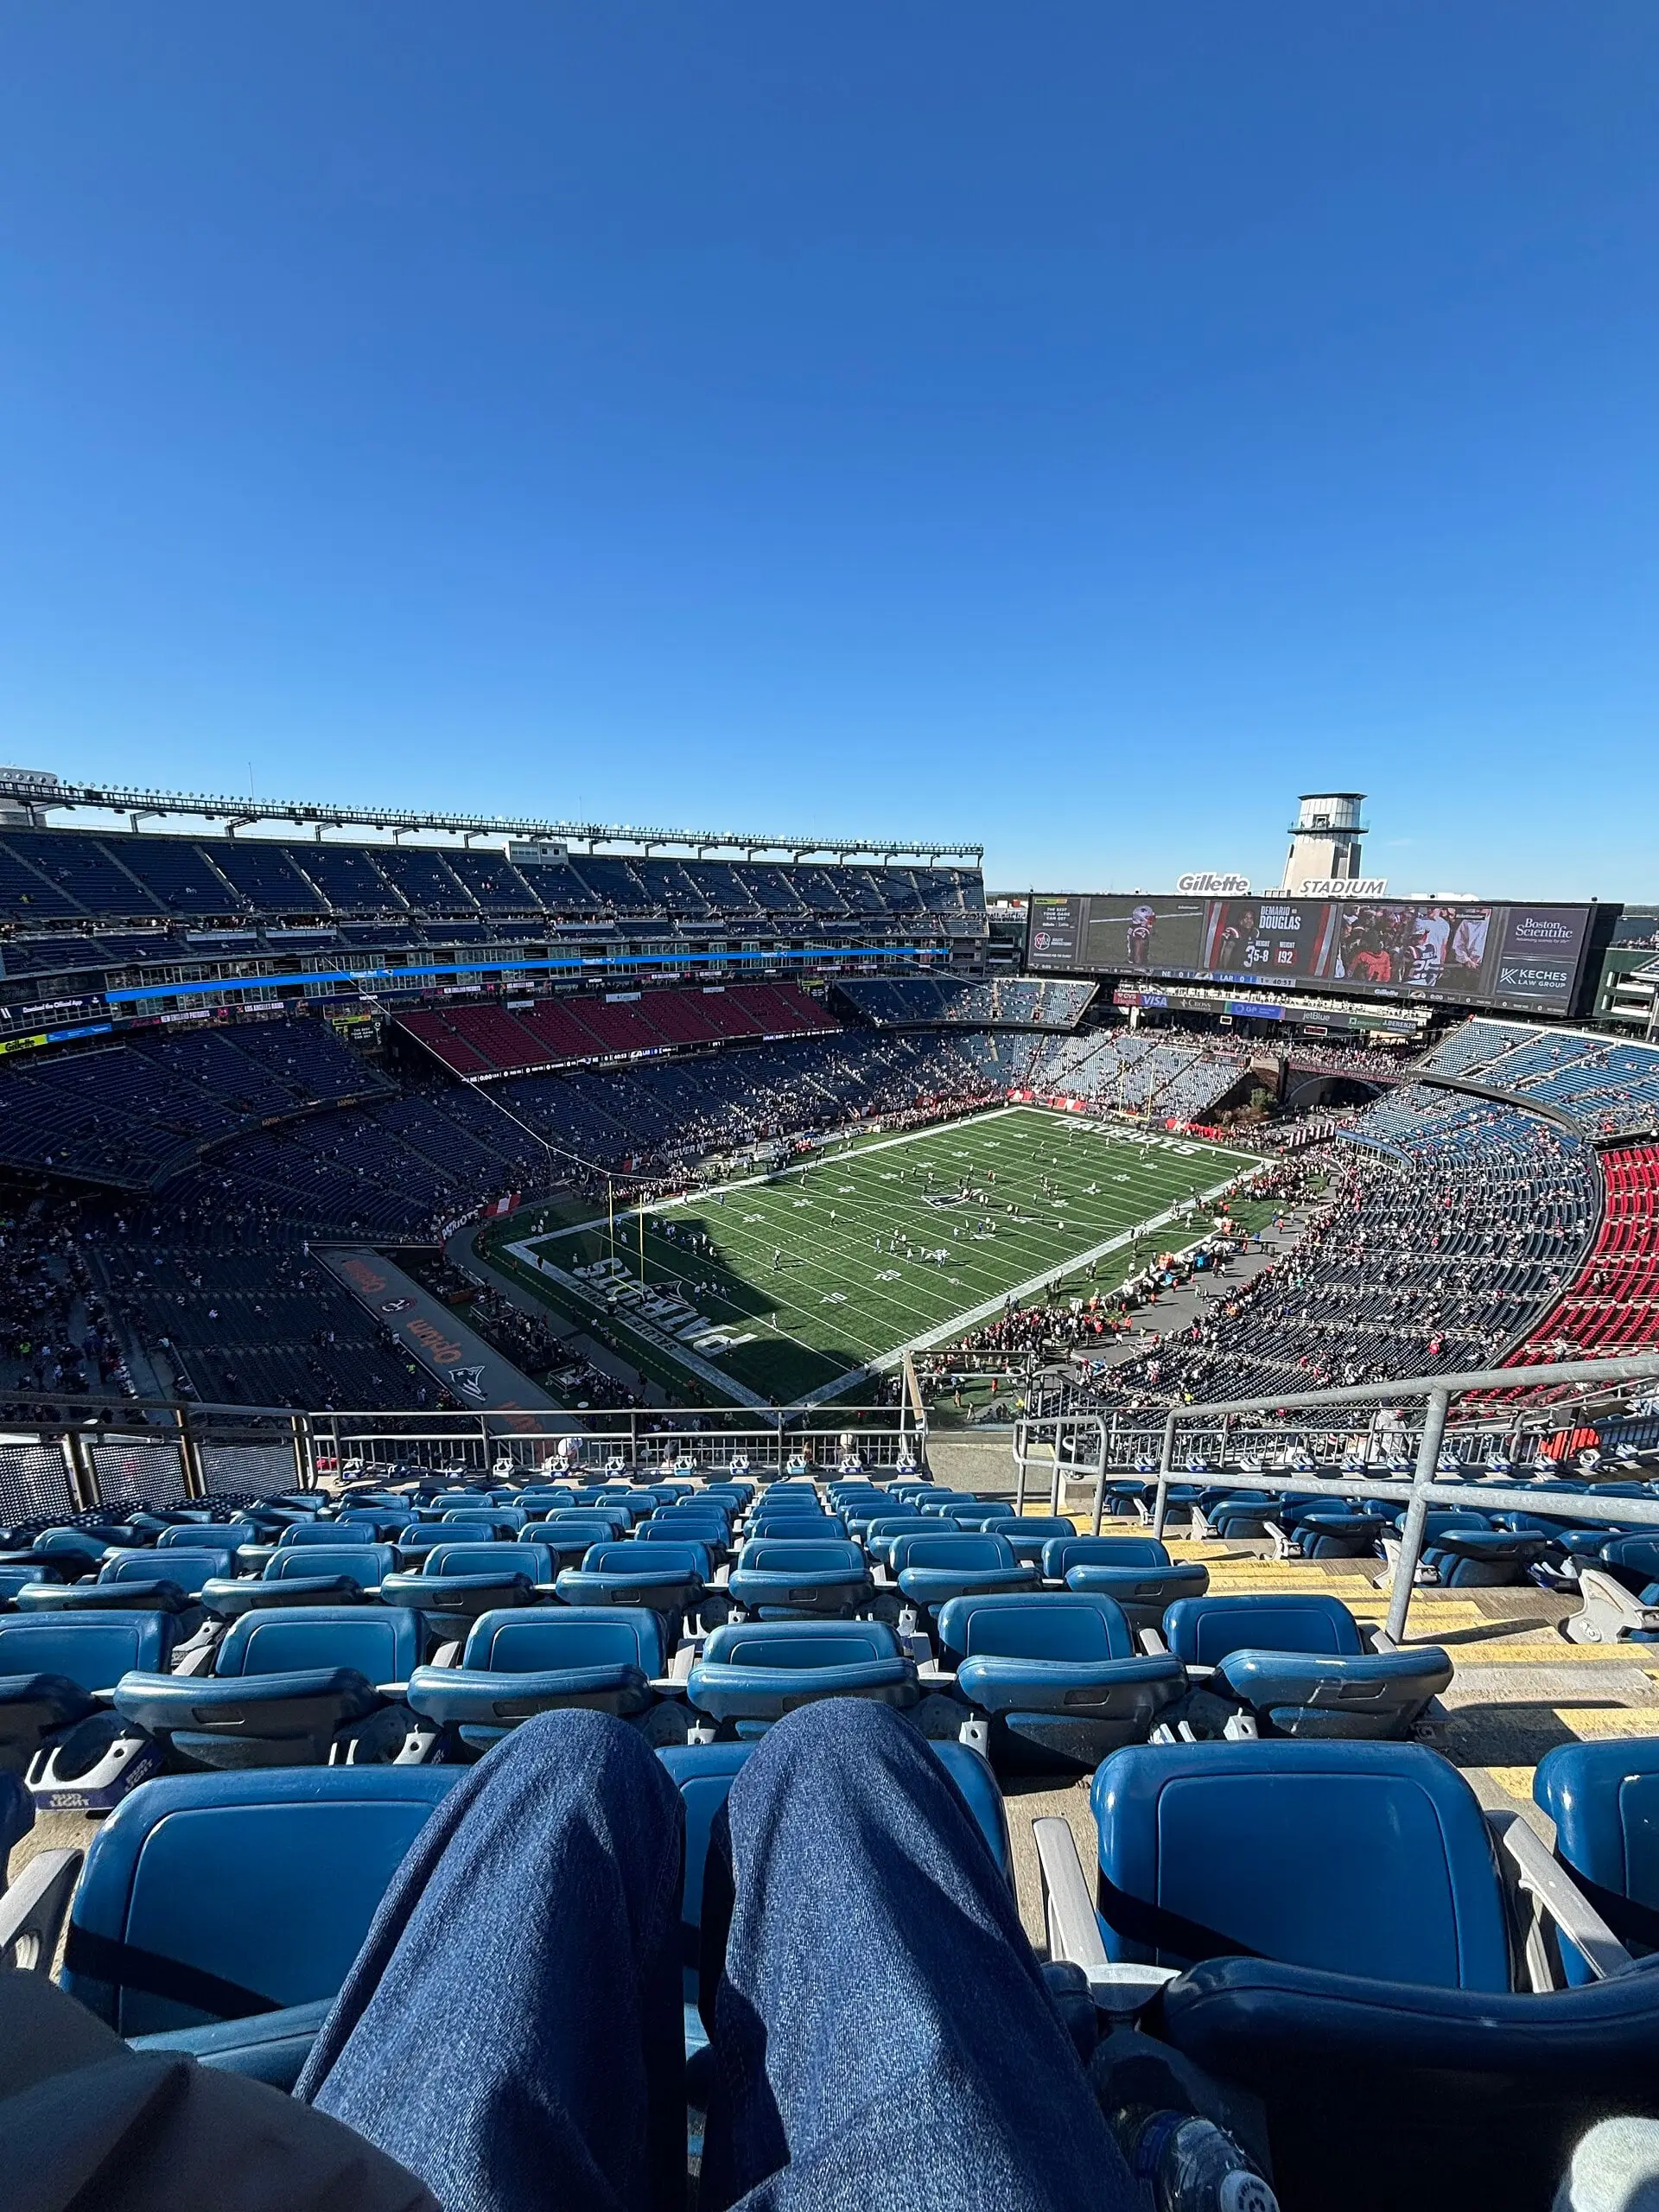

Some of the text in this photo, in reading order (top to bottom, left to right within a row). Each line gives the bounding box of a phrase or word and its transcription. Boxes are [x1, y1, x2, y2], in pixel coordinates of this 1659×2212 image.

[1179, 874, 1384, 894] Gillette STADIUM
[1261, 906, 1290, 916] DEMARIO
[1259, 916, 1301, 930] DOUGLAS
[1524, 918, 1560, 929] Boston
[1516, 924, 1573, 938] Scientific
[1254, 950, 1294, 964] 5-8 192
[1519, 969, 1567, 982] KECHES
[1142, 995, 1167, 1007] VISA
[1302, 1011, 1331, 1022] jetBlue
[4, 1038, 35, 1052] Gillette
[1319, 1066, 1344, 1077] TOYOTA
[1347, 1070, 1375, 1081] TOYOTA
[1051, 1119, 1202, 1156] PATRIOTS
[874, 1269, 902, 1281] 20
[819, 1293, 848, 1304] 10
[572, 1257, 759, 1358] PATRIOTS
[49, 1798, 91, 1808] LIGHT
[50, 1792, 83, 1801] BUD
